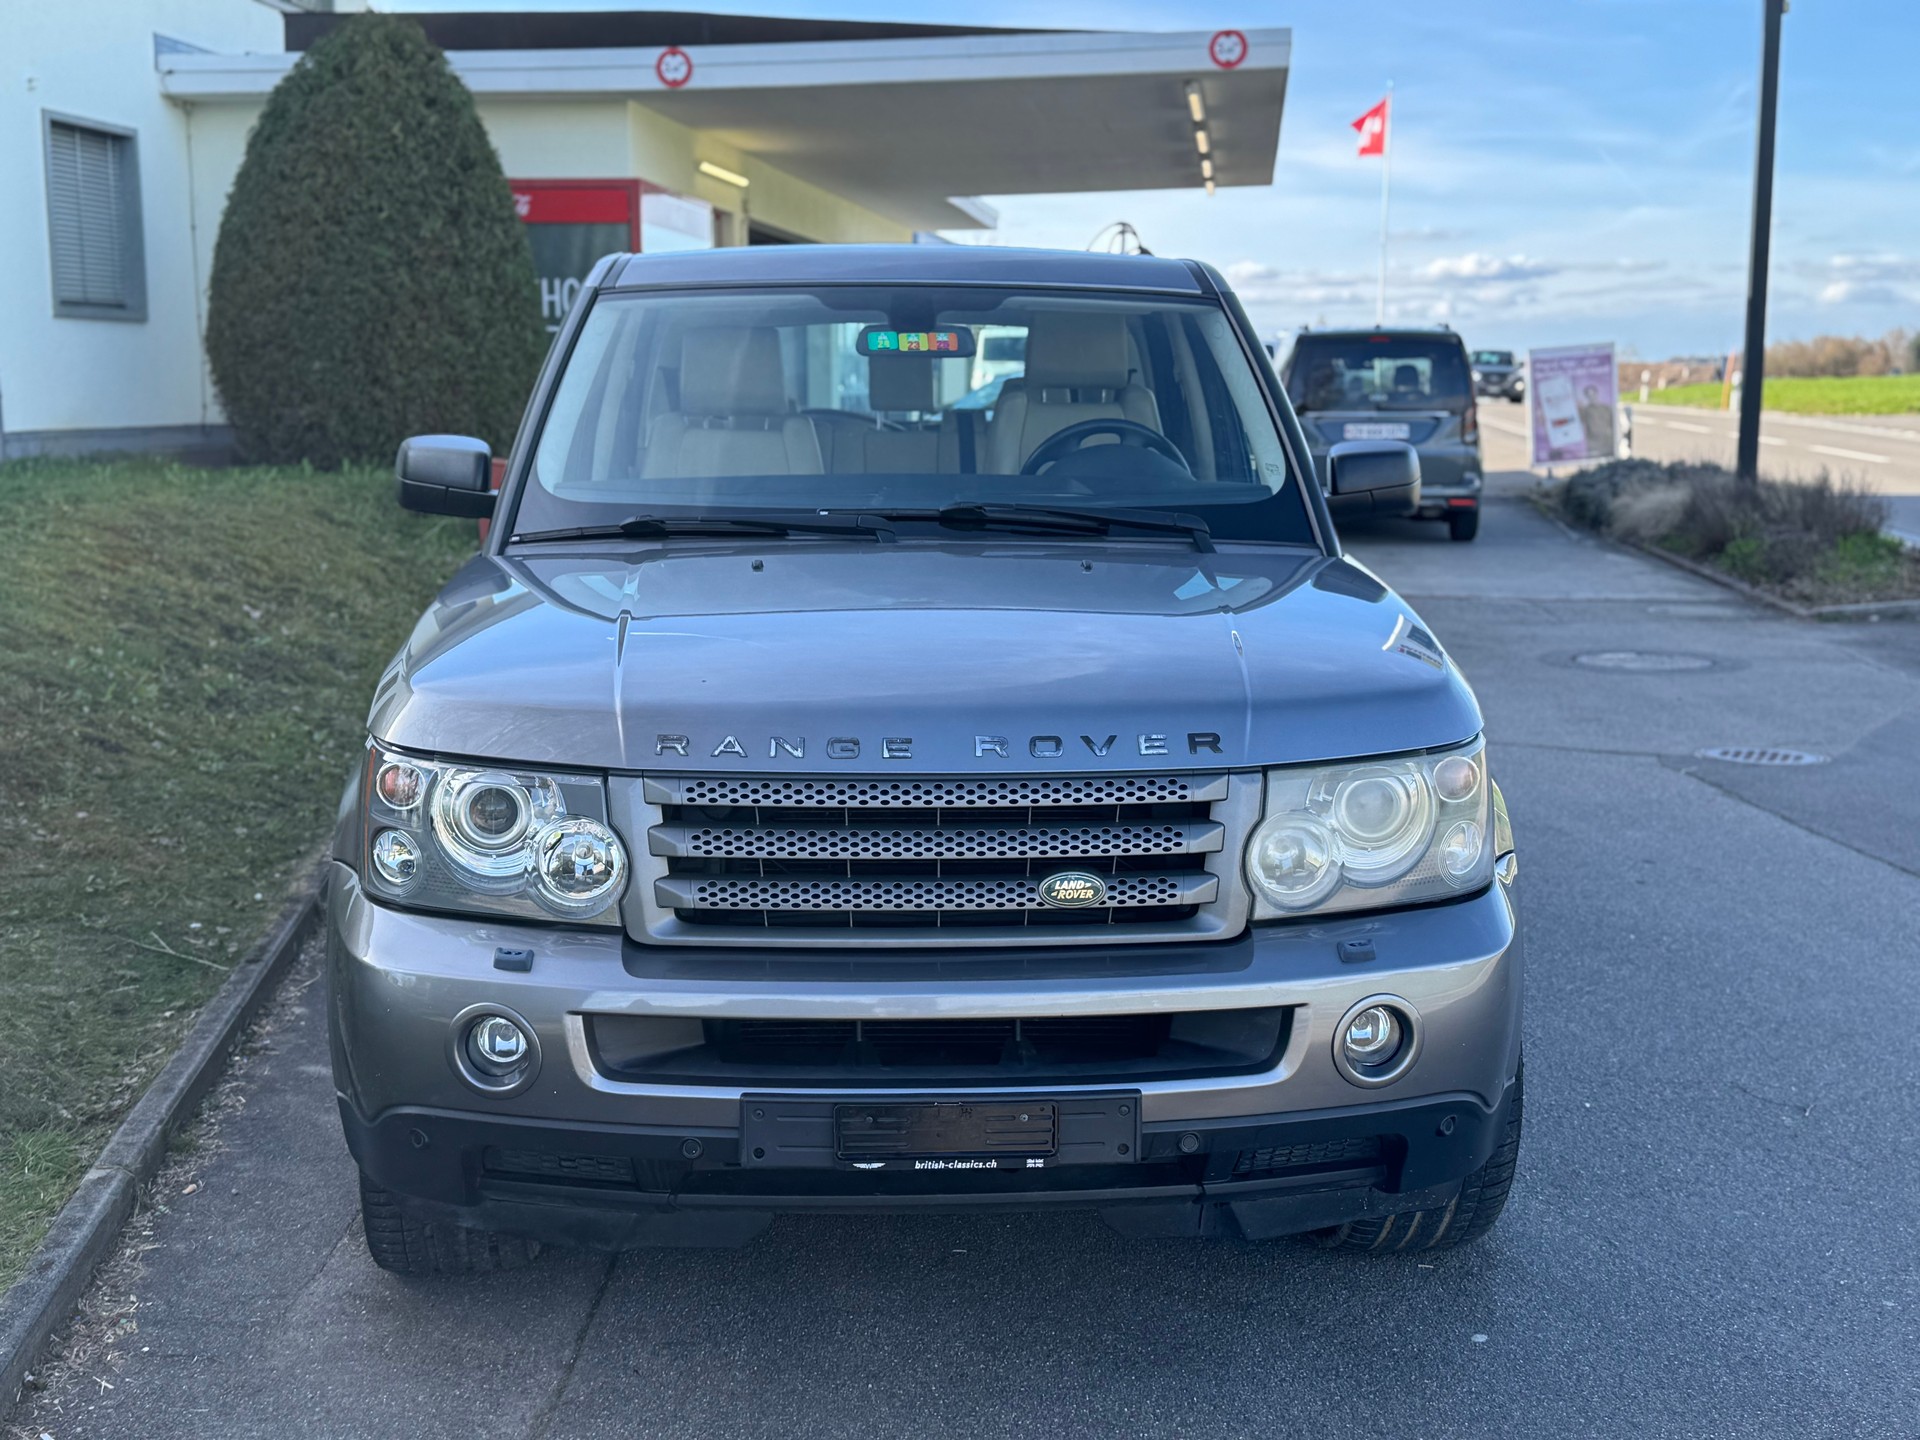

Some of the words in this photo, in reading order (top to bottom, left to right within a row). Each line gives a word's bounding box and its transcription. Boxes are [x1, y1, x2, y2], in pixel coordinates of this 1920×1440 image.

[655, 733, 912, 760] RANGE
[974, 732, 1224, 759] ROVER
[1054, 880, 1085, 890] LAND
[1057, 889, 1094, 899] ROVER
[914, 1158, 998, 1170] british-classics.ch
